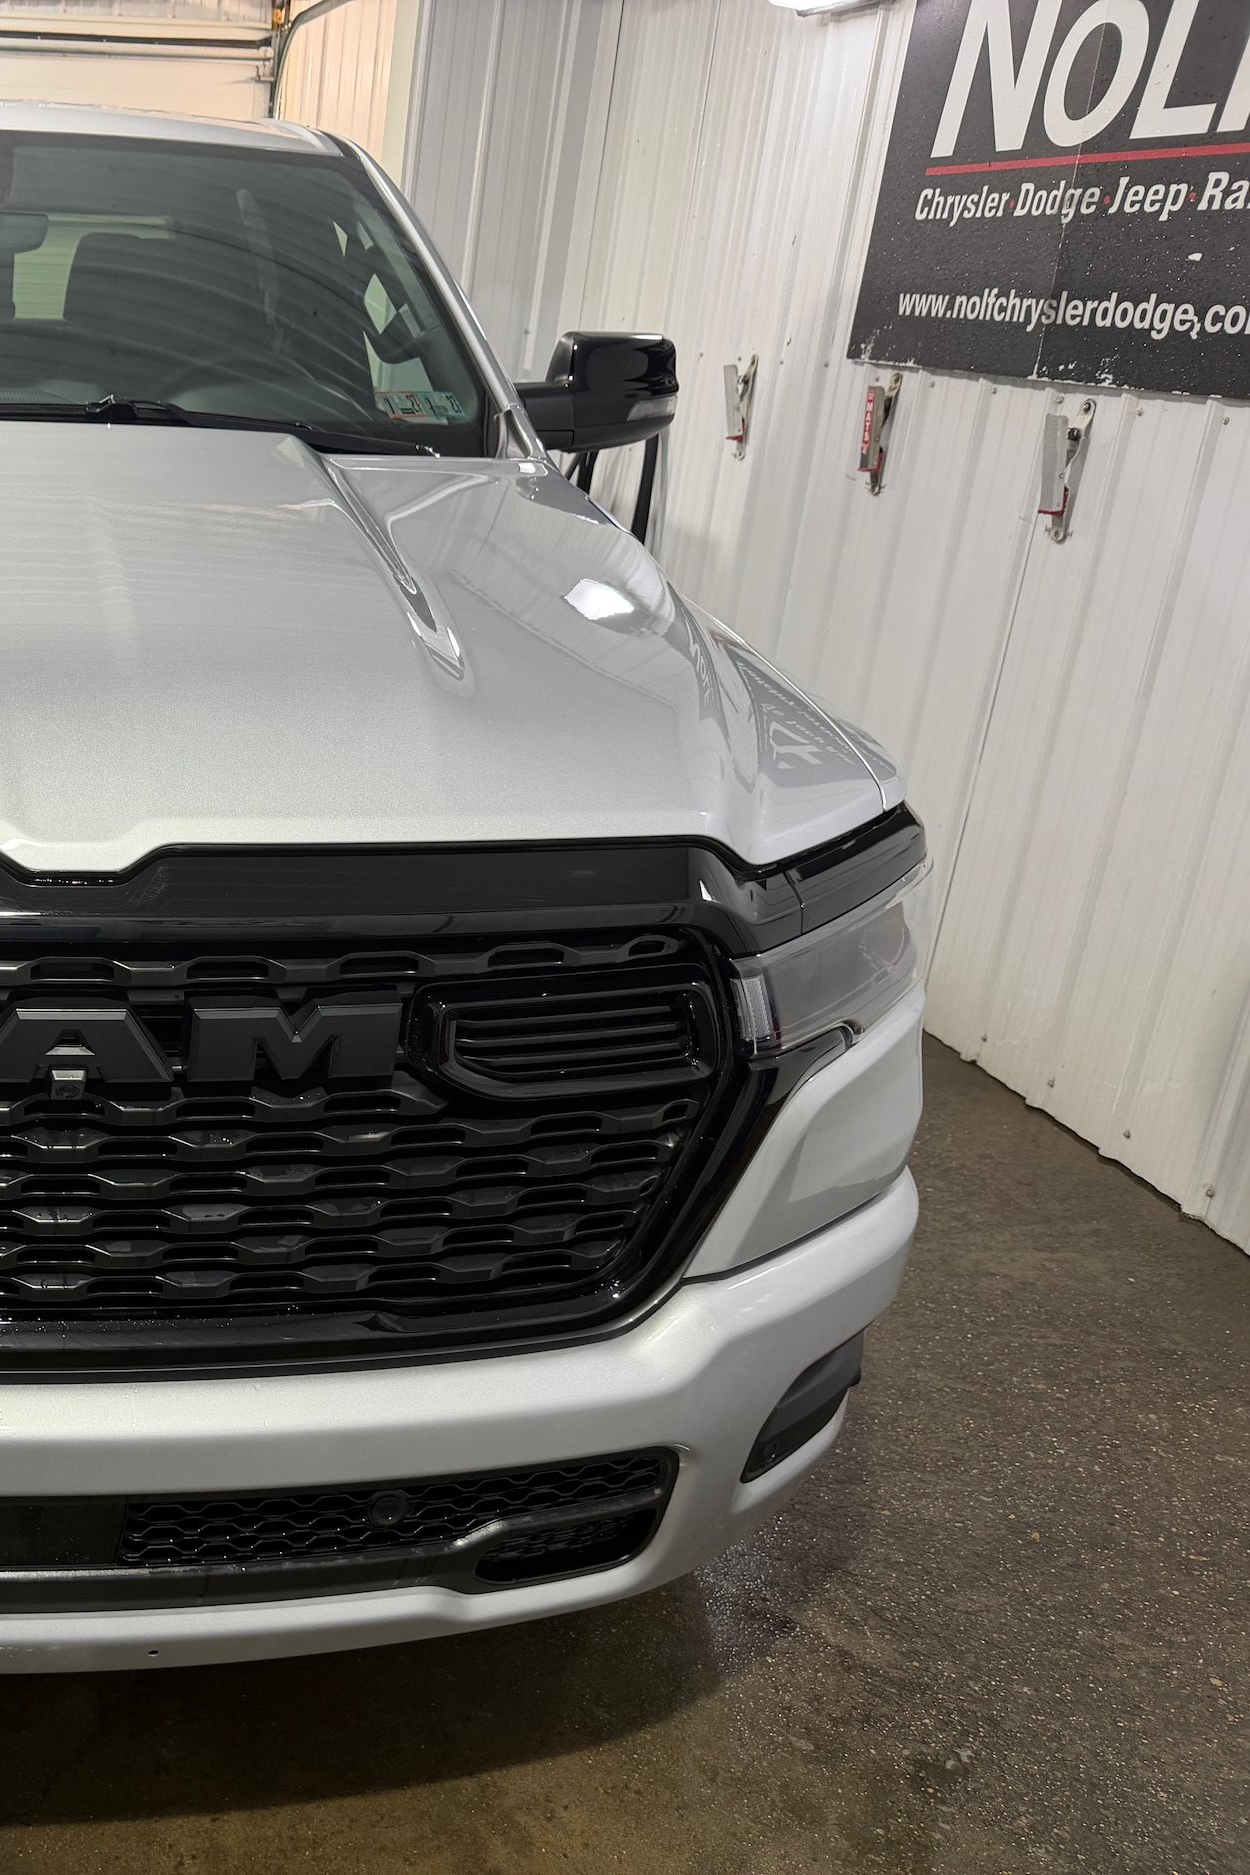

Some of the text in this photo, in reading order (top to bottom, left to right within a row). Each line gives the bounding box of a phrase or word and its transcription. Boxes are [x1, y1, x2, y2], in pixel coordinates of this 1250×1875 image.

[930, 0, 1250, 158] NOL
[915, 171, 1250, 228] Chrysler Dodge Jeep Ra
[898, 287, 1250, 340] www.nolfchryslerdodge.co
